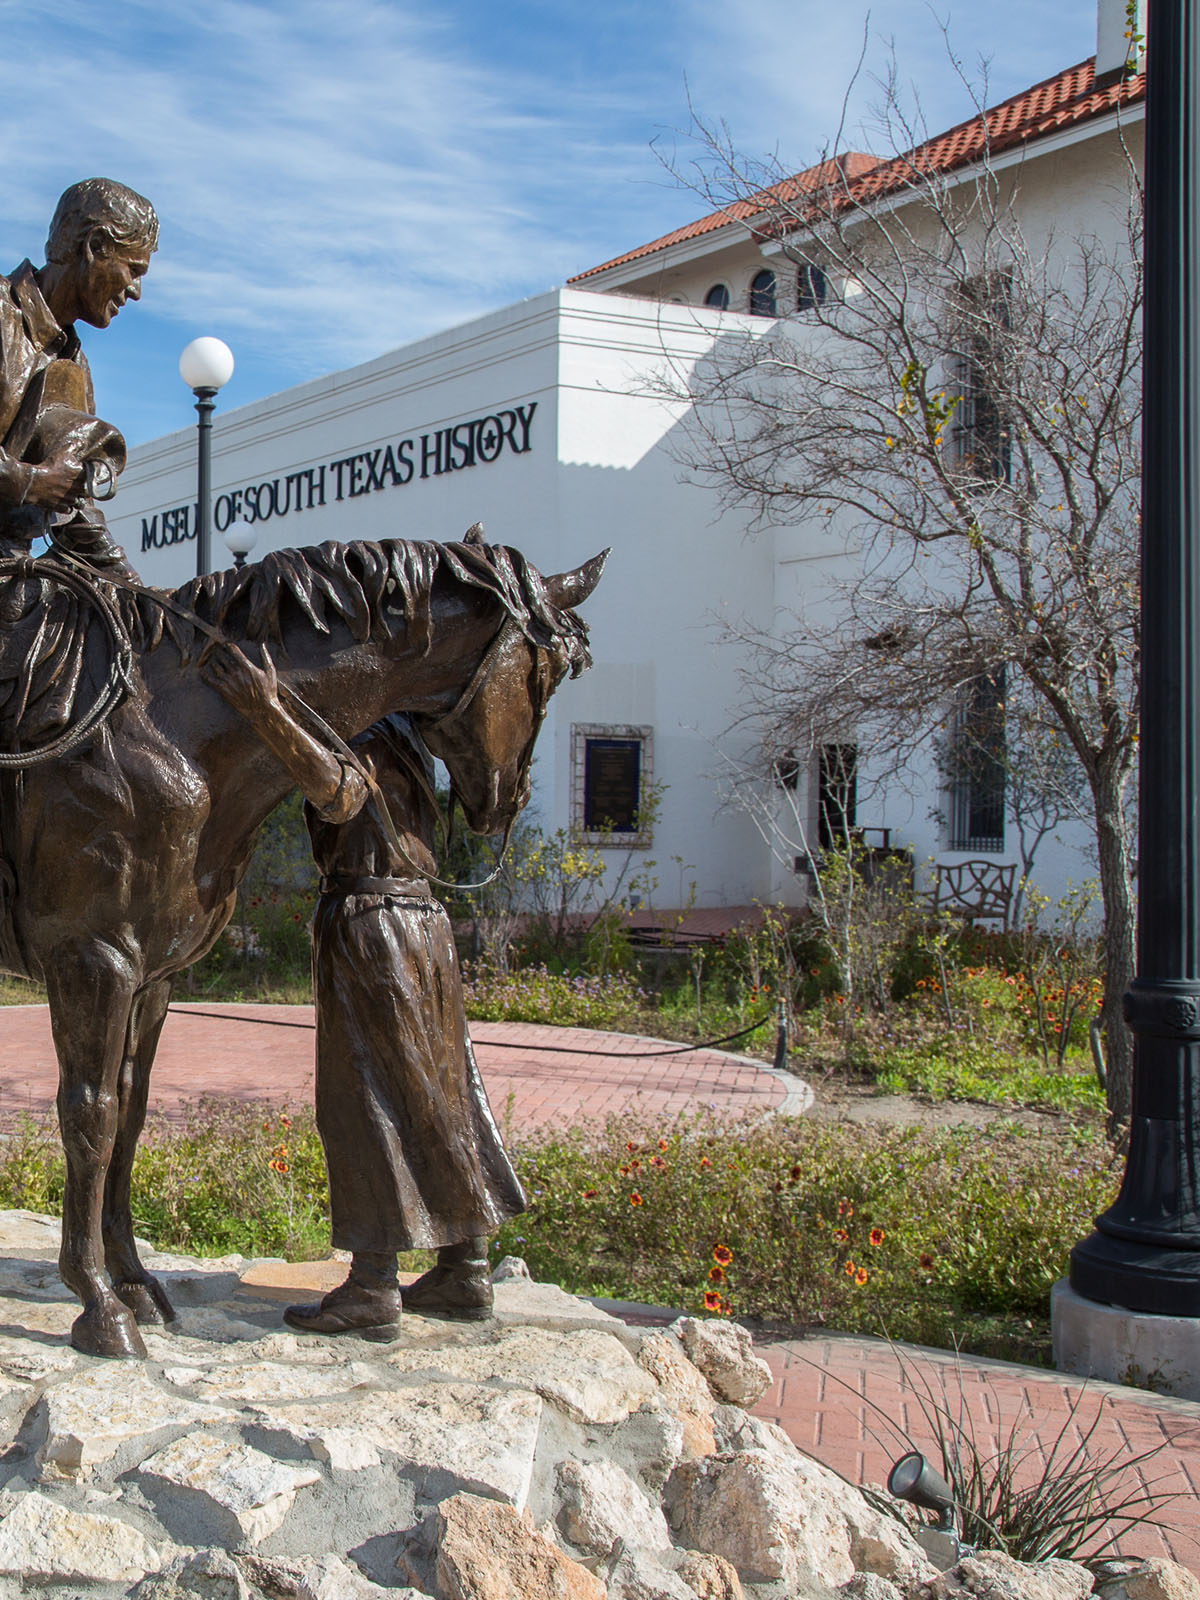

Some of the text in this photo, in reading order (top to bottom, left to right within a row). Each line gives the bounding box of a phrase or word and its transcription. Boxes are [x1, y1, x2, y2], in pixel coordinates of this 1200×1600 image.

[140, 402, 538, 552] MUSEU OF SOUTH TEXAS HISTORY
